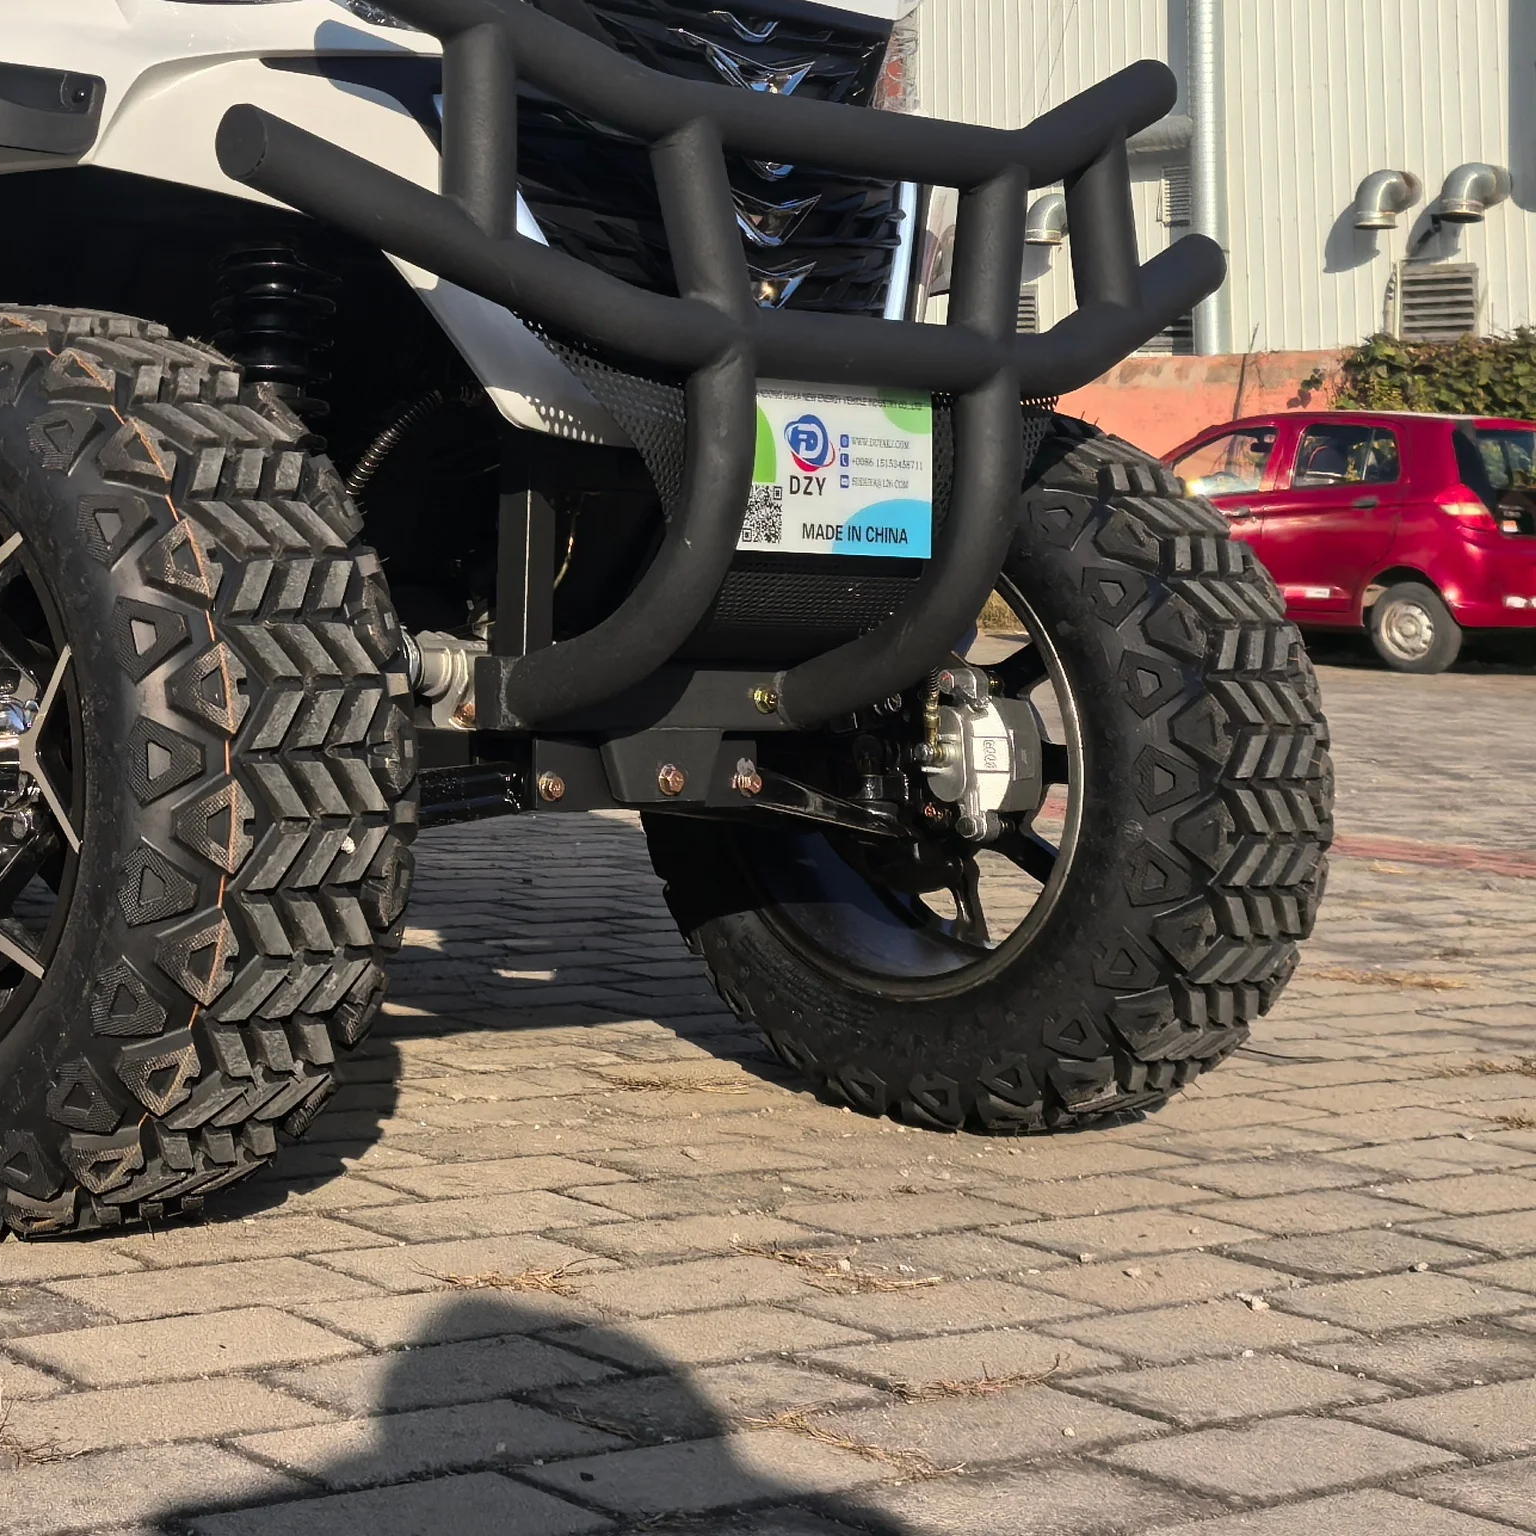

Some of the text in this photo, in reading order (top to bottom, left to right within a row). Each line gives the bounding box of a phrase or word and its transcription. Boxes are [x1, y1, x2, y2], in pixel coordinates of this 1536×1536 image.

[789, 475, 827, 496] DZY
[802, 523, 908, 545] MADE IN CHINA
